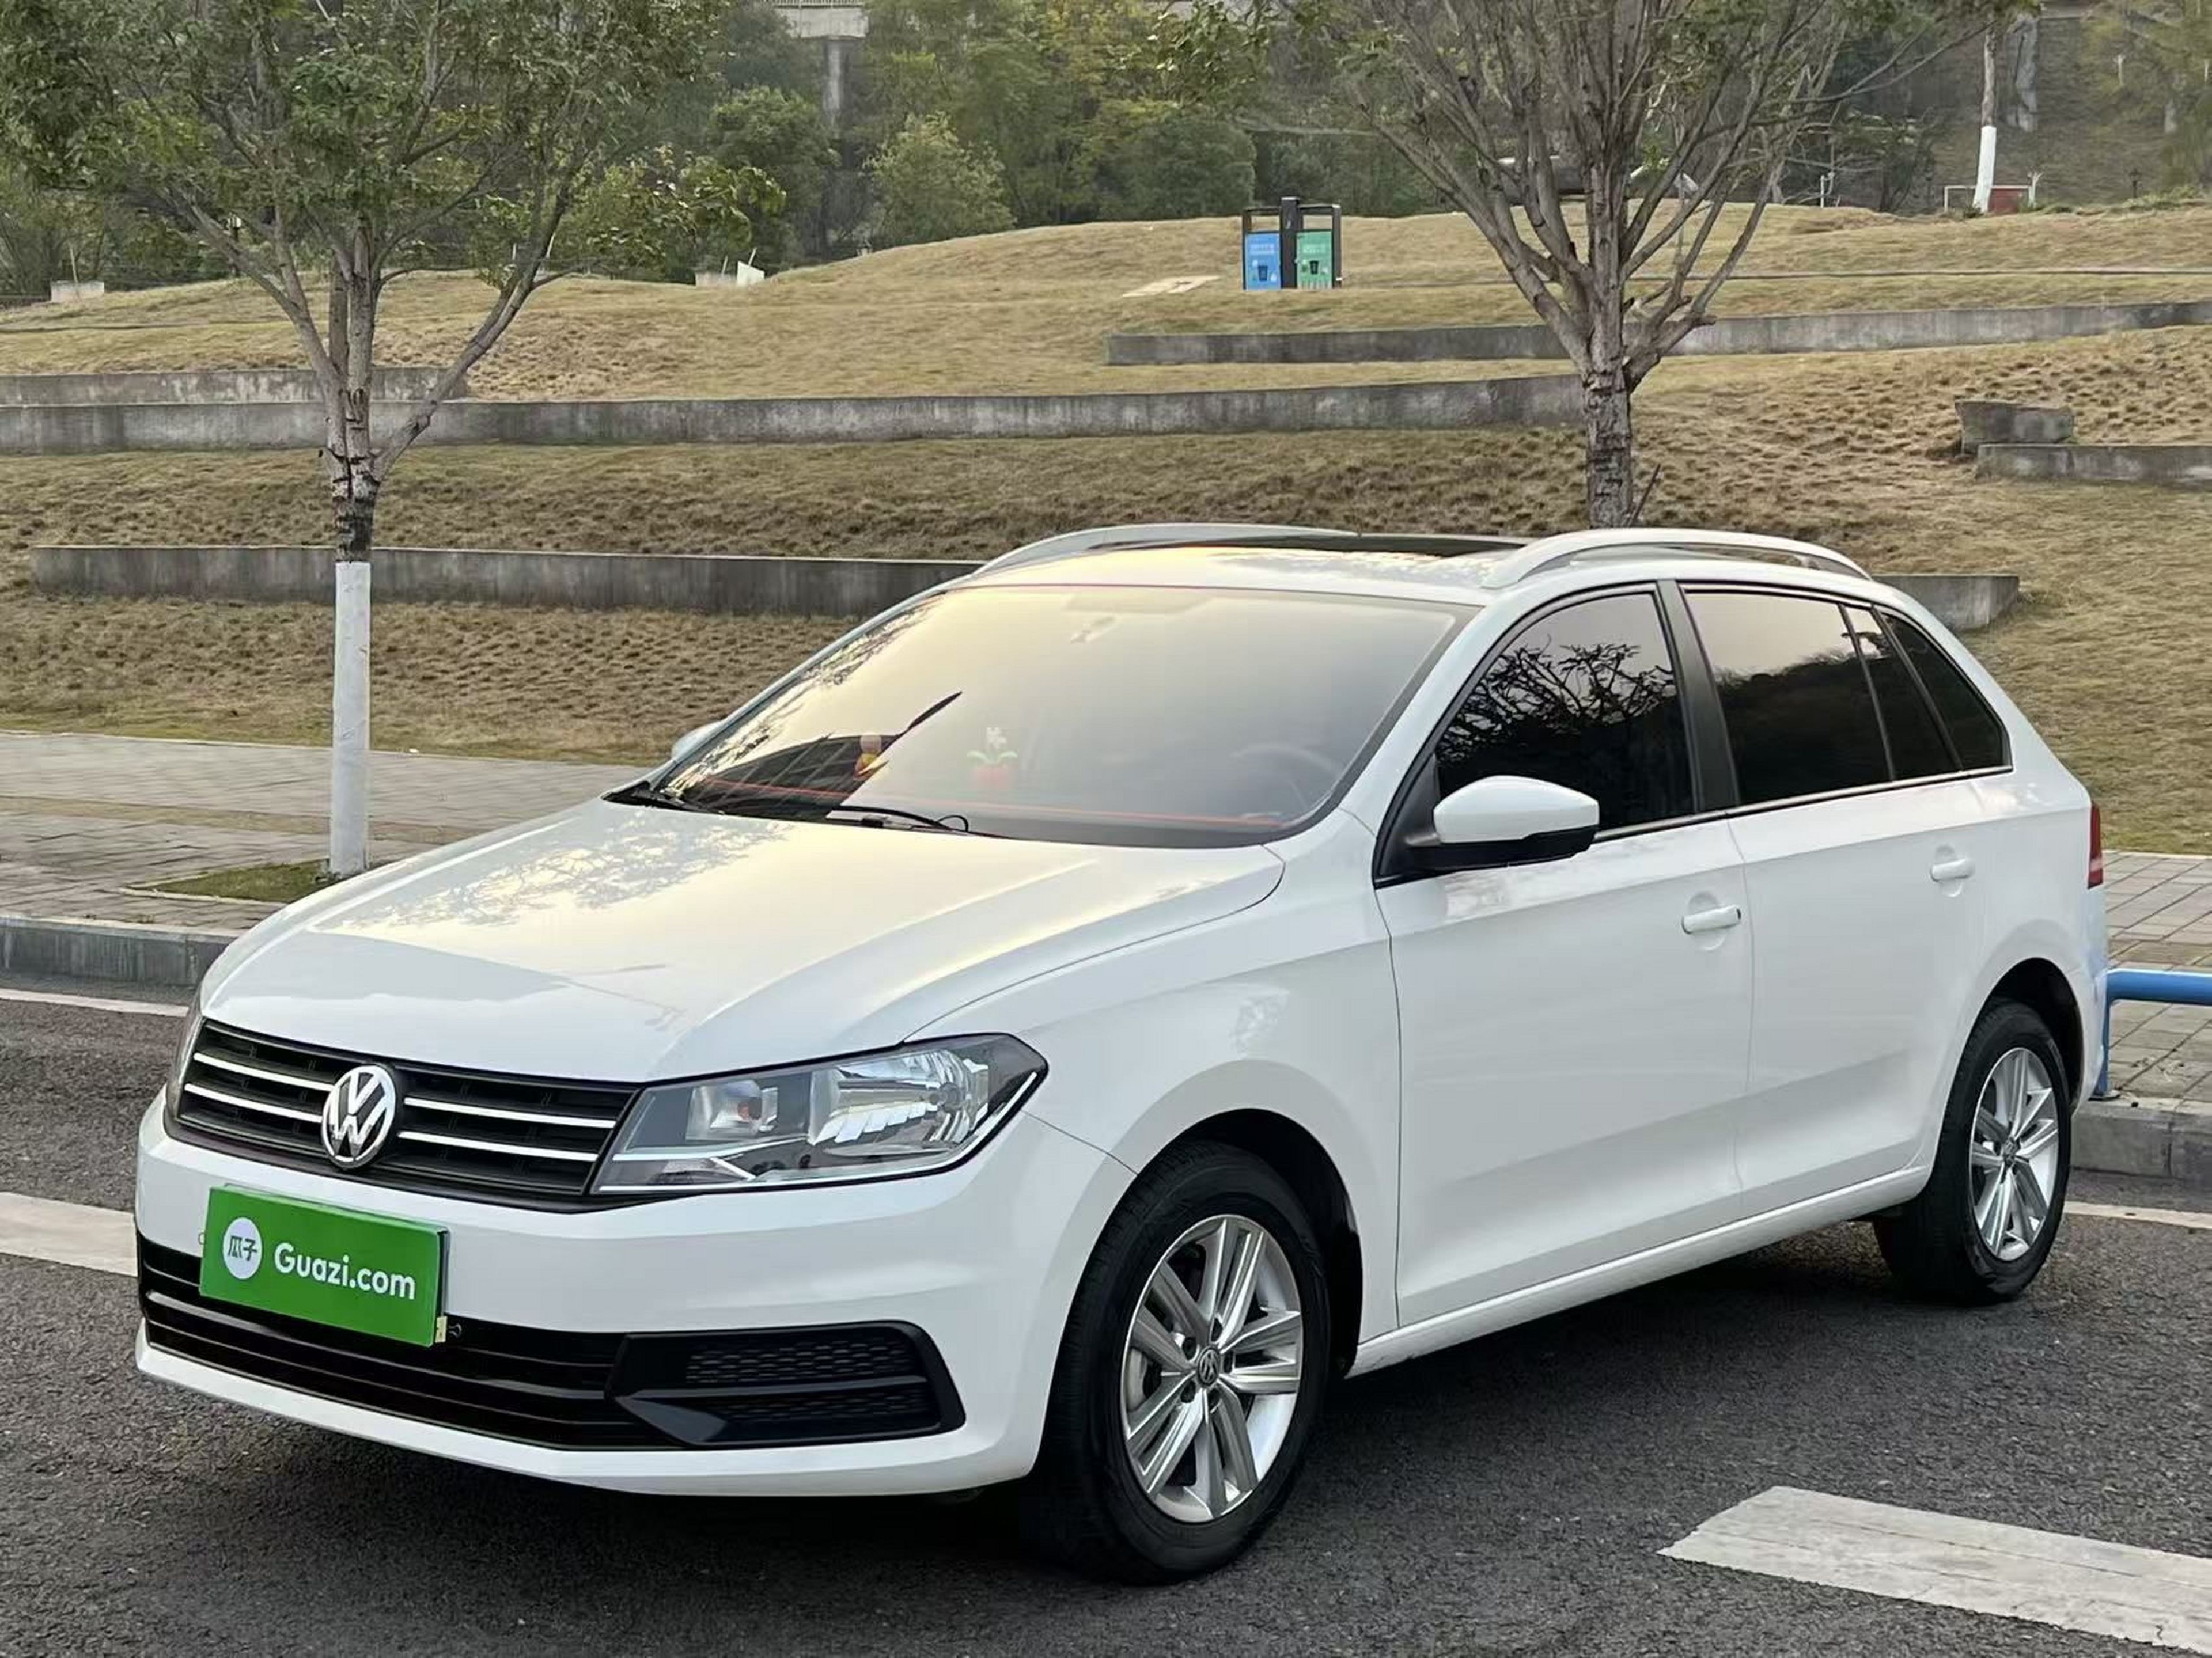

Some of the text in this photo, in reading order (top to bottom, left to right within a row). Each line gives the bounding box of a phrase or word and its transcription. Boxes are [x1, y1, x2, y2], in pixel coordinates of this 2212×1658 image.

[323, 1066, 395, 1163] VW
[228, 1235, 257, 1261] 瓜子
[274, 1242, 415, 1300] Guazi.com
